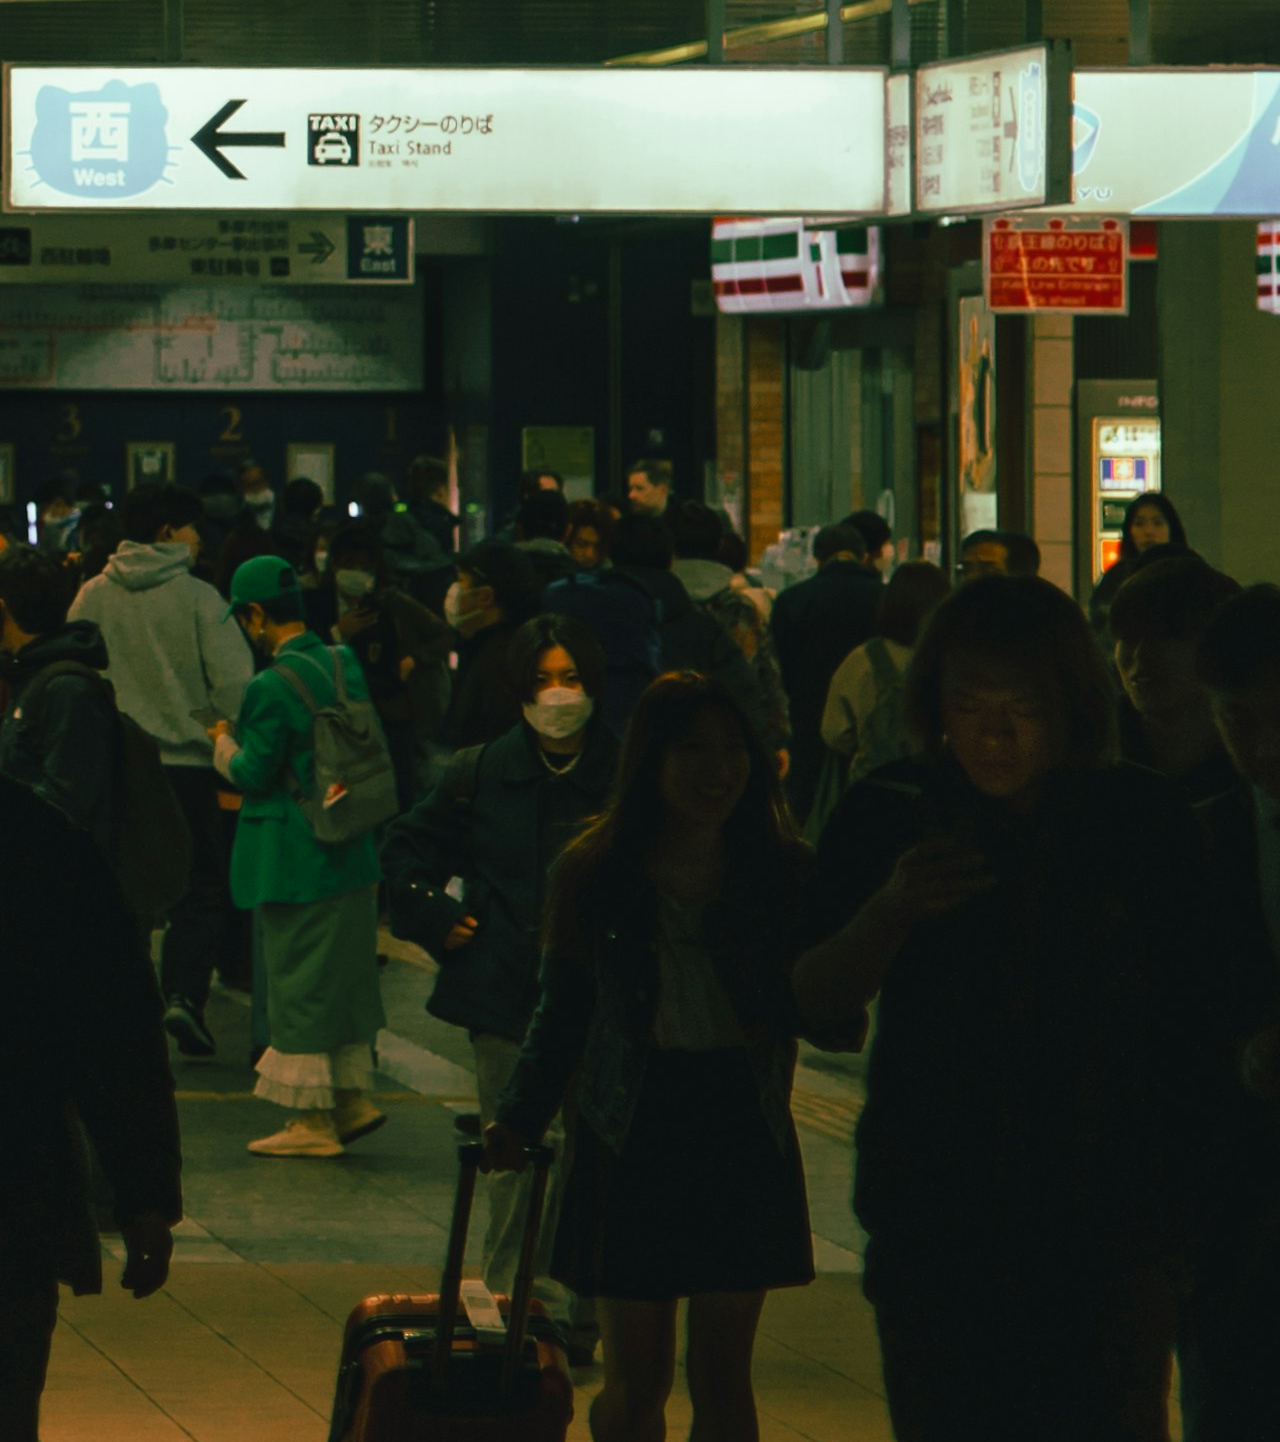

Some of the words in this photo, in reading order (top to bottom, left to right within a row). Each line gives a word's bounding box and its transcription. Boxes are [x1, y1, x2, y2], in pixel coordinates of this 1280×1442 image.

[69, 102, 131, 163] 西
[309, 115, 357, 131] TAXI
[369, 114, 494, 135] タクシーのりば
[369, 140, 400, 155] Taxi
[407, 140, 452, 155] Stand
[73, 167, 126, 187] West
[218, 405, 243, 442] 2
